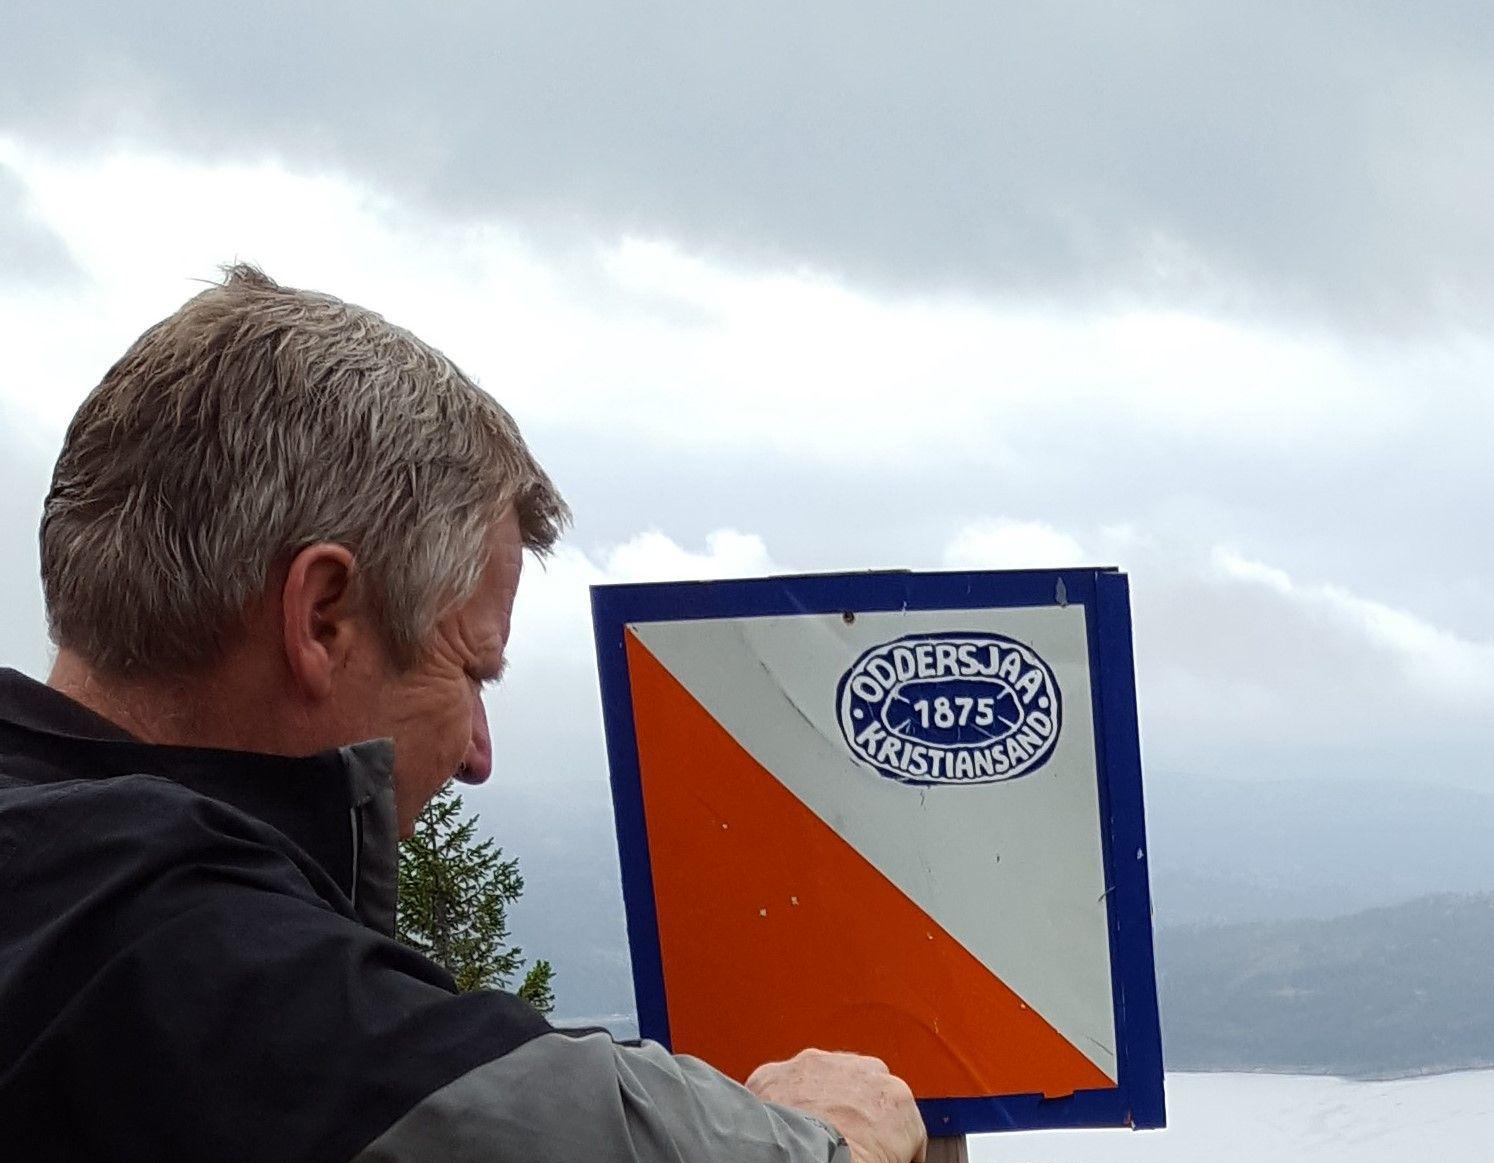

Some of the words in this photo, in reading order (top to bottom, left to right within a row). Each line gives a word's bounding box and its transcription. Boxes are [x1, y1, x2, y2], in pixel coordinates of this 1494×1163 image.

[852, 644, 1043, 704] ODDERSJAA
[913, 696, 995, 729] 1875
[857, 711, 1053, 779] KRISTIANSAND
